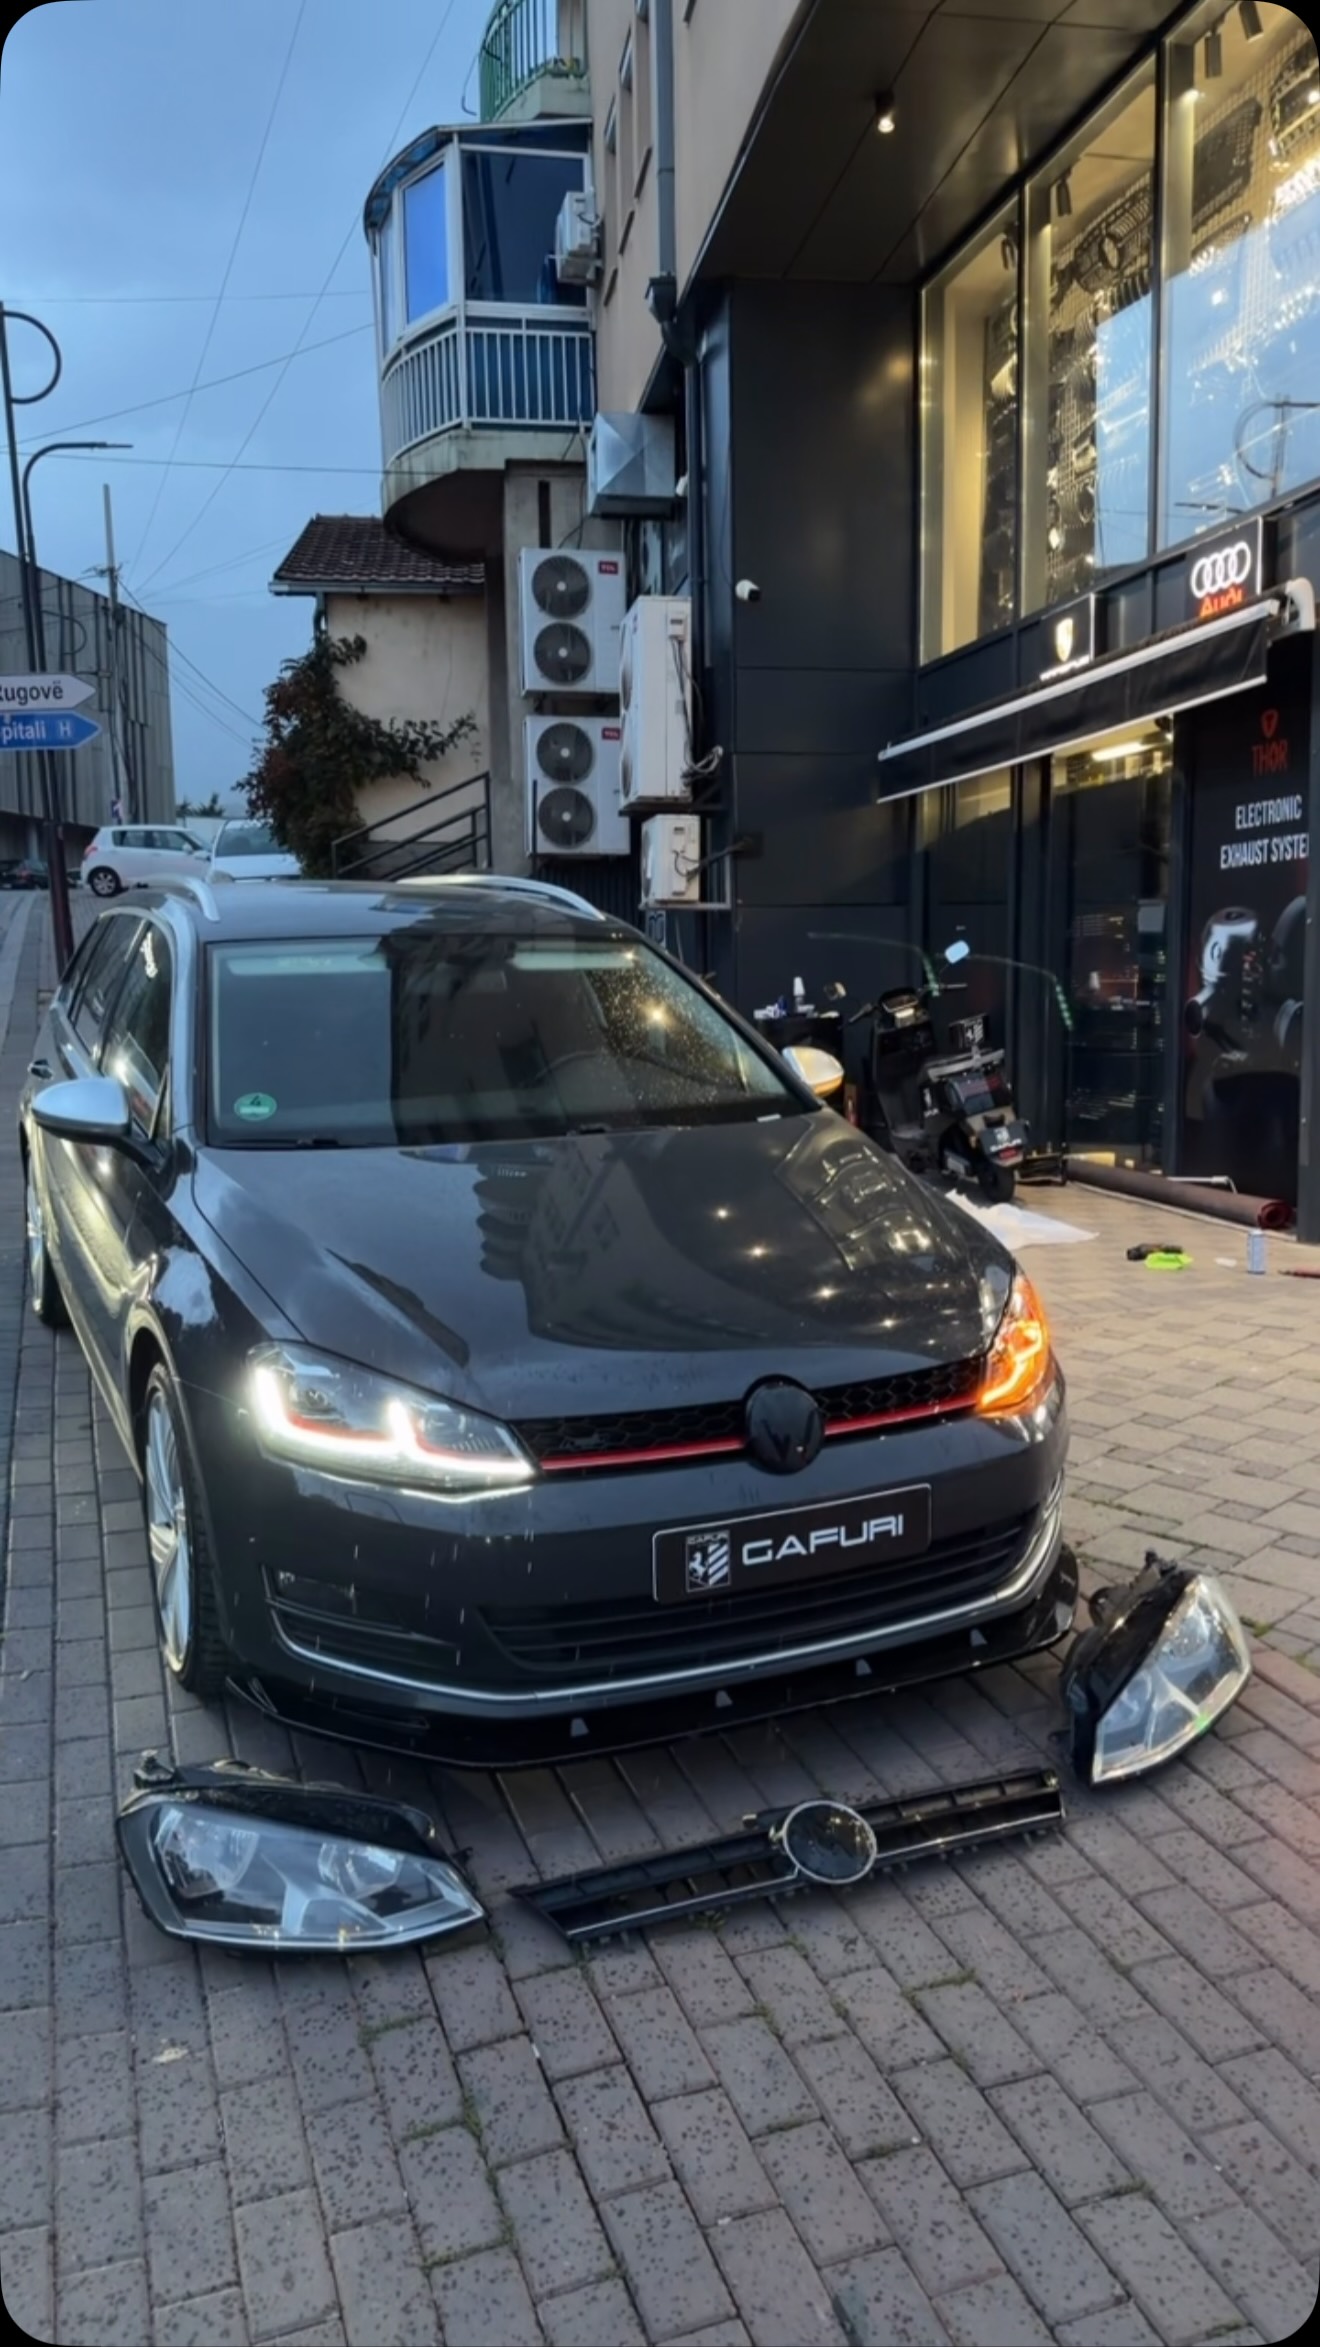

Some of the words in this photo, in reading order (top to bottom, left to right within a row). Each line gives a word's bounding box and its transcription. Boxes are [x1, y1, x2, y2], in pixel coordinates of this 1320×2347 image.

[1200, 585, 1243, 617] Audi
[2, 720, 47, 745] pitali
[1252, 739, 1288, 776] THOR
[1235, 794, 1302, 830] ELECTRONIC
[1220, 838, 1269, 870] EXHAUST
[742, 1514, 903, 1566] GAFURI
